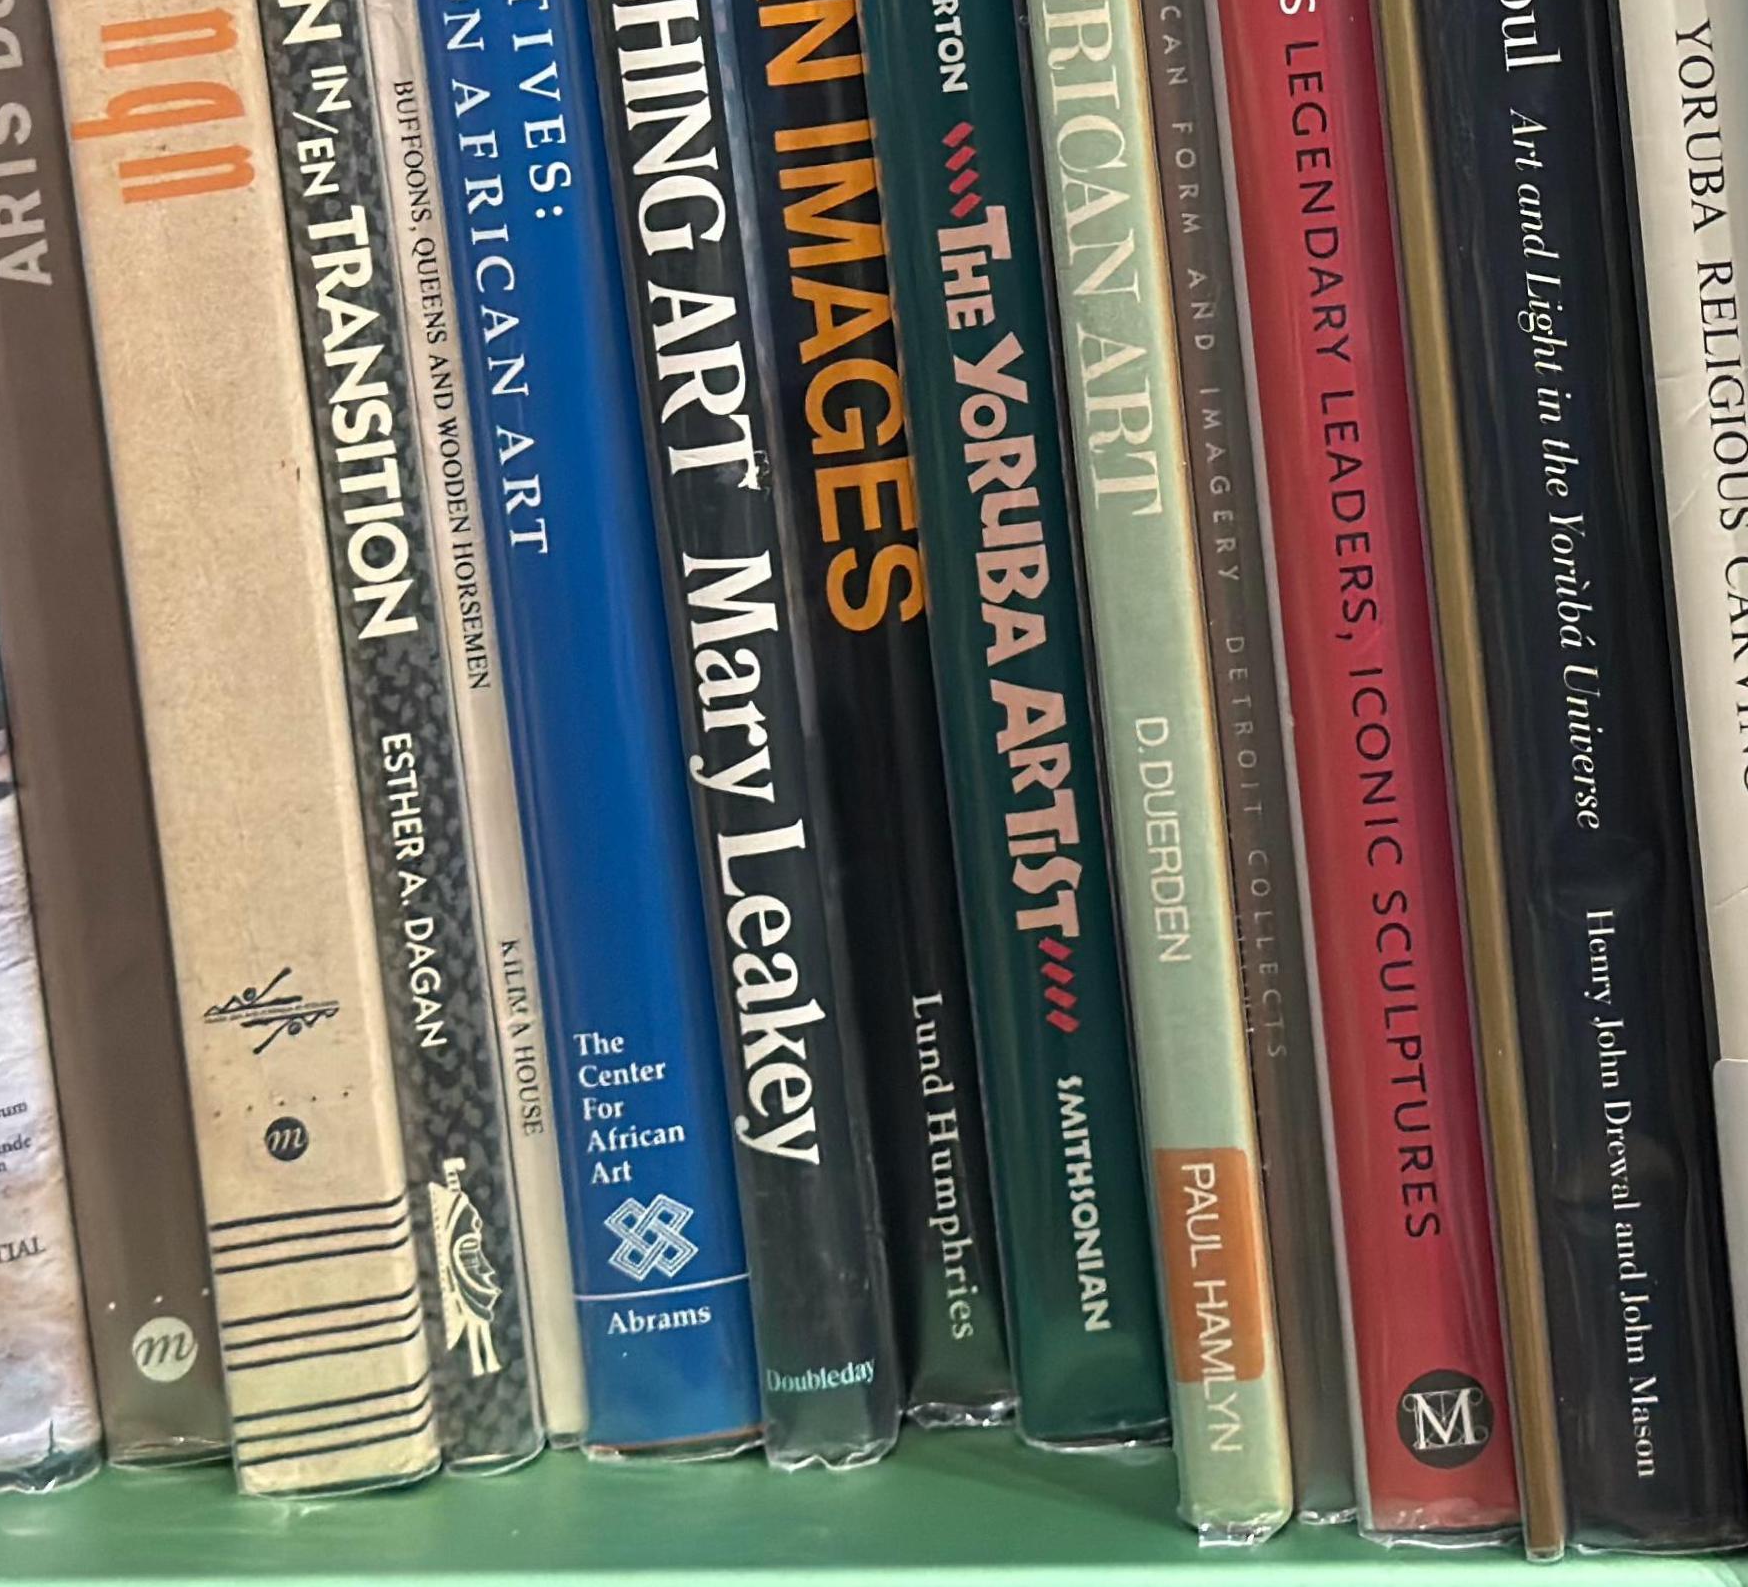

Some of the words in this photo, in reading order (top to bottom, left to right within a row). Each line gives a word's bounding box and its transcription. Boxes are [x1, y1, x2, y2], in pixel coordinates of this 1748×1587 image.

[393, 79, 432, 232] BUFFOONS,
[1170, 120, 1204, 235] FORM
[1284, 39, 1352, 365] LEGENDARY
[1674, 17, 1729, 234] YORUBA
[411, 237, 448, 344] QUEENS
[428, 353, 454, 411] AND
[451, 77, 530, 398] AFRICAN
[495, 424, 549, 555] ART
[648, 280, 762, 491] ART
[774, 117, 929, 633] IMAGES
[1186, 267, 1216, 352] AND
[307, 204, 420, 641] TRANSITION
[438, 414, 470, 532] WOODEN
[1076, 322, 1164, 518] ART
[1198, 386, 1240, 582] IMAGERY
[1319, 388, 1378, 643] LEADERS,
[452, 540, 492, 690] HORSEMEN
[682, 549, 779, 804] Mary
[1225, 635, 1263, 815] DETROIT
[1247, 849, 1288, 1059] COLLECTS
[1348, 666, 1405, 869] ICONIC
[716, 818, 827, 1167] Leakey
[1371, 888, 1442, 1240] SCULPTURES
[1057, 1074, 1111, 1333] SMITHSONIAN
[1181, 1160, 1224, 1269] PAUL
[607, 1301, 712, 1336] Abrams
[1193, 1278, 1244, 1455] HAMLYN
